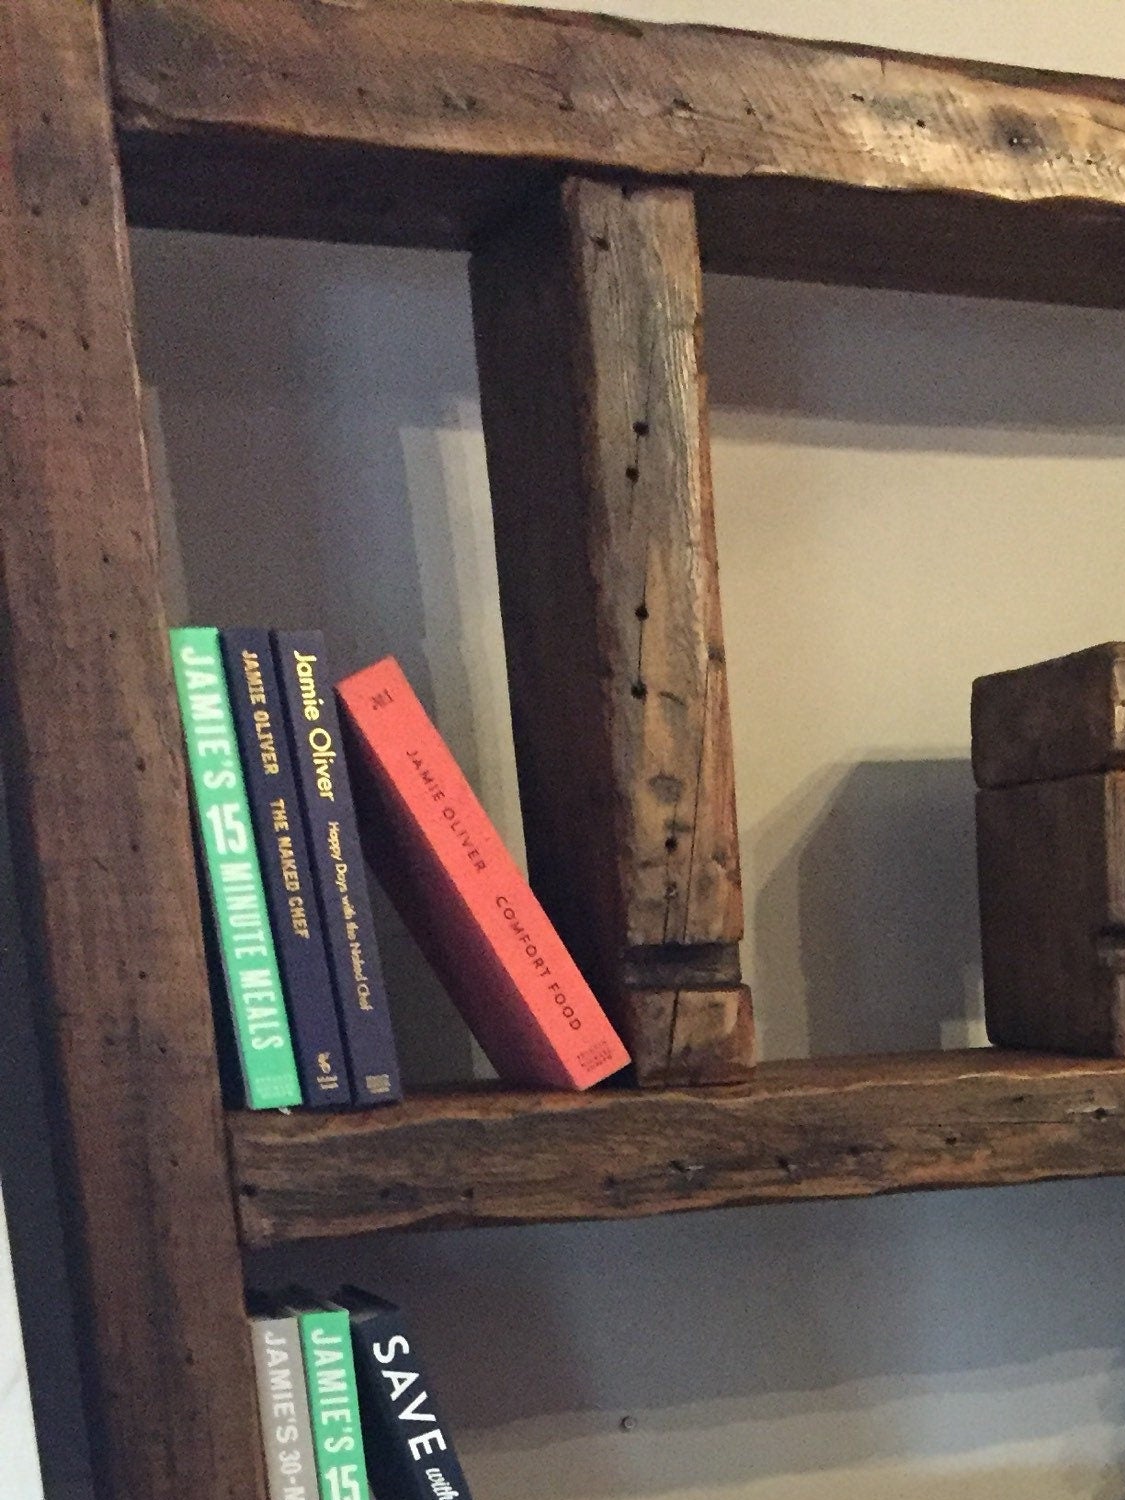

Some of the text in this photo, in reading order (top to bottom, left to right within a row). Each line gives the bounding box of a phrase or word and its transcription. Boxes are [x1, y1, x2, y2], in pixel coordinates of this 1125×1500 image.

[180, 646, 236, 790] JAMIE'S
[242, 650, 280, 776] JAMIE OLIVER
[294, 650, 338, 802] Jamie Oliver
[206, 803, 250, 855] 15
[270, 798, 310, 940] THE NAKED CHEF
[327, 821, 343, 862] Happy
[335, 863, 348, 893] Days
[406, 750, 487, 873] JAMIE OLIVER
[219, 862, 266, 959] MINUTE
[494, 895, 582, 1032] COMFORT FOOD
[240, 967, 284, 1050] MEALS
[264, 1331, 298, 1442] JAMIE'S
[311, 1327, 355, 1454] JAMIE'S
[372, 1335, 447, 1461] SAVE
